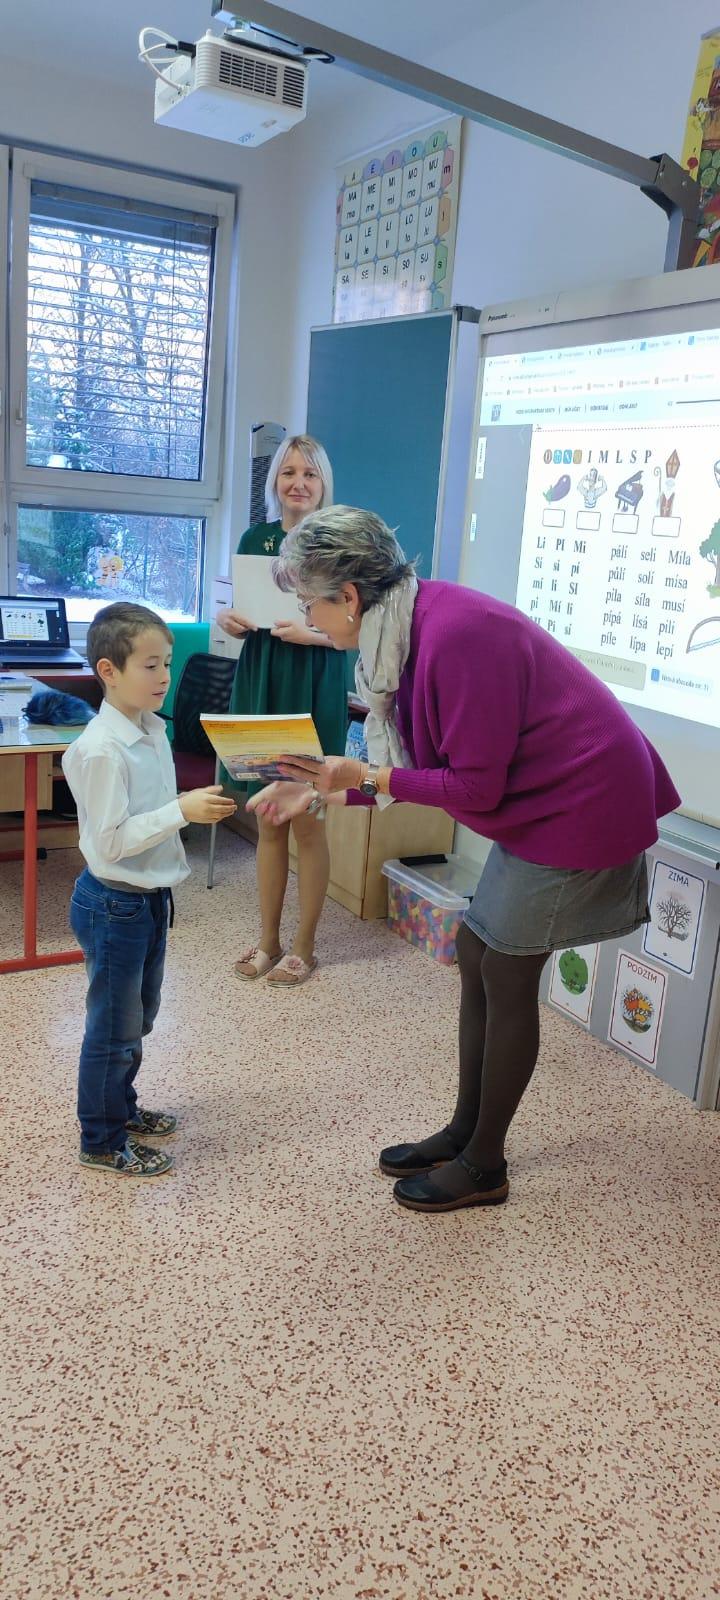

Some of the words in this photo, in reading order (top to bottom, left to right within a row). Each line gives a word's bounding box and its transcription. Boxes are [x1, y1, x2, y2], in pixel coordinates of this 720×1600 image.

[370, 164, 375, 173] E
[411, 148, 417, 157] O
[432, 138, 438, 148] U
[348, 191, 357, 201] MA
[367, 184, 376, 194] ME
[388, 177, 396, 187] MI
[408, 168, 418, 179] MO
[429, 158, 439, 170] MU
[443, 165, 451, 174] m
[345, 234, 353, 243] LA
[365, 227, 372, 237] LE
[386, 221, 392, 231] LI
[405, 214, 414, 225] LO
[425, 206, 433, 217] LU
[341, 275, 350, 284] SA
[361, 270, 369, 279] SE
[382, 265, 389, 275] SI
[402, 259, 411, 270] SO
[420, 252, 429, 263] SU
[587, 450, 592, 463] I
[599, 450, 609, 463] M
[616, 450, 623, 463] L
[629, 449, 637, 463] S
[644, 450, 652, 463] P
[635, 592, 650, 607] síla
[633, 614, 648, 629] lísá
[601, 632, 617, 647] píle
[668, 870, 689, 887] ZIMA
[627, 961, 658, 983] PODZIM
